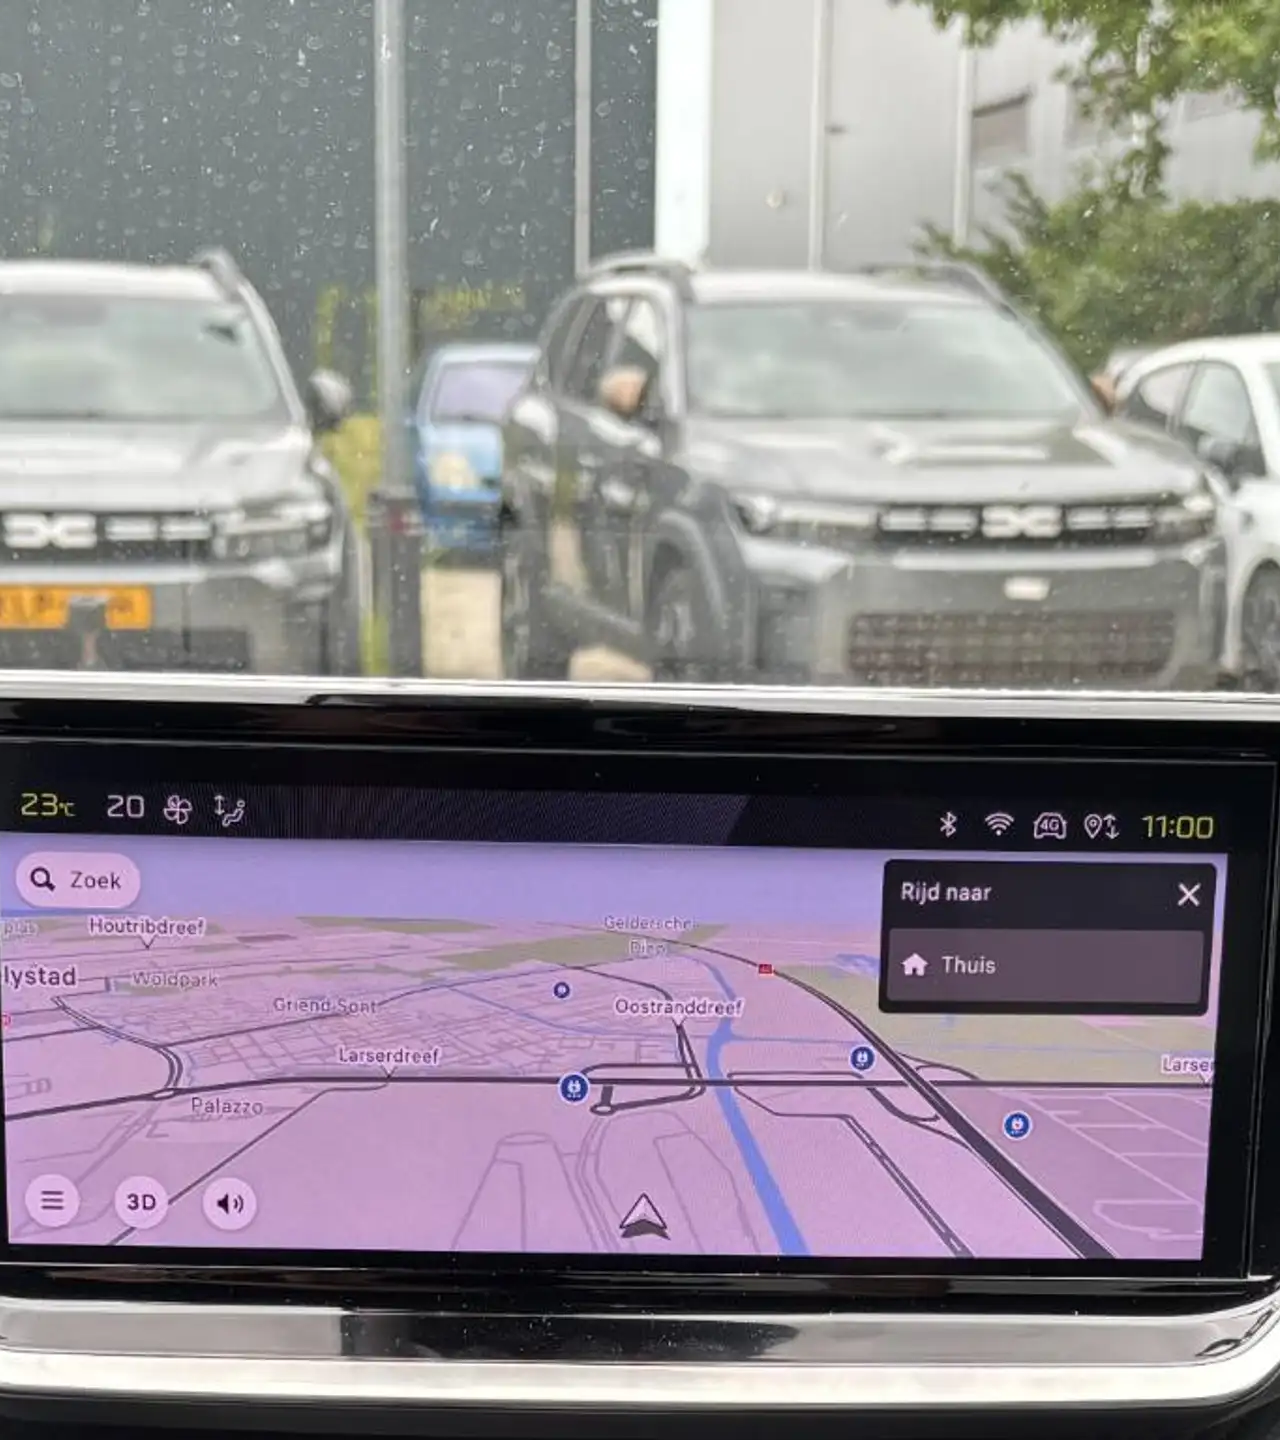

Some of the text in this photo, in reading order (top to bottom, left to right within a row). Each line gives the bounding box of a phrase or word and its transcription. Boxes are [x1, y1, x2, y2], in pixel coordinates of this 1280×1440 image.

[107, 795, 145, 817] 20
[1142, 815, 1214, 839] 11:00
[70, 871, 122, 890] Zoek
[901, 882, 992, 904] Rijd naar
[89, 917, 205, 936] Houtribdreef
[942, 955, 997, 975] Thuis
[4, 965, 77, 988] lystad
[132, 972, 218, 990] Woldpark
[615, 999, 743, 1015] Oostranddreef
[338, 1047, 441, 1065] Larserdreef
[191, 1097, 264, 1115] Palazzo
[127, 1193, 156, 1211] 3D
